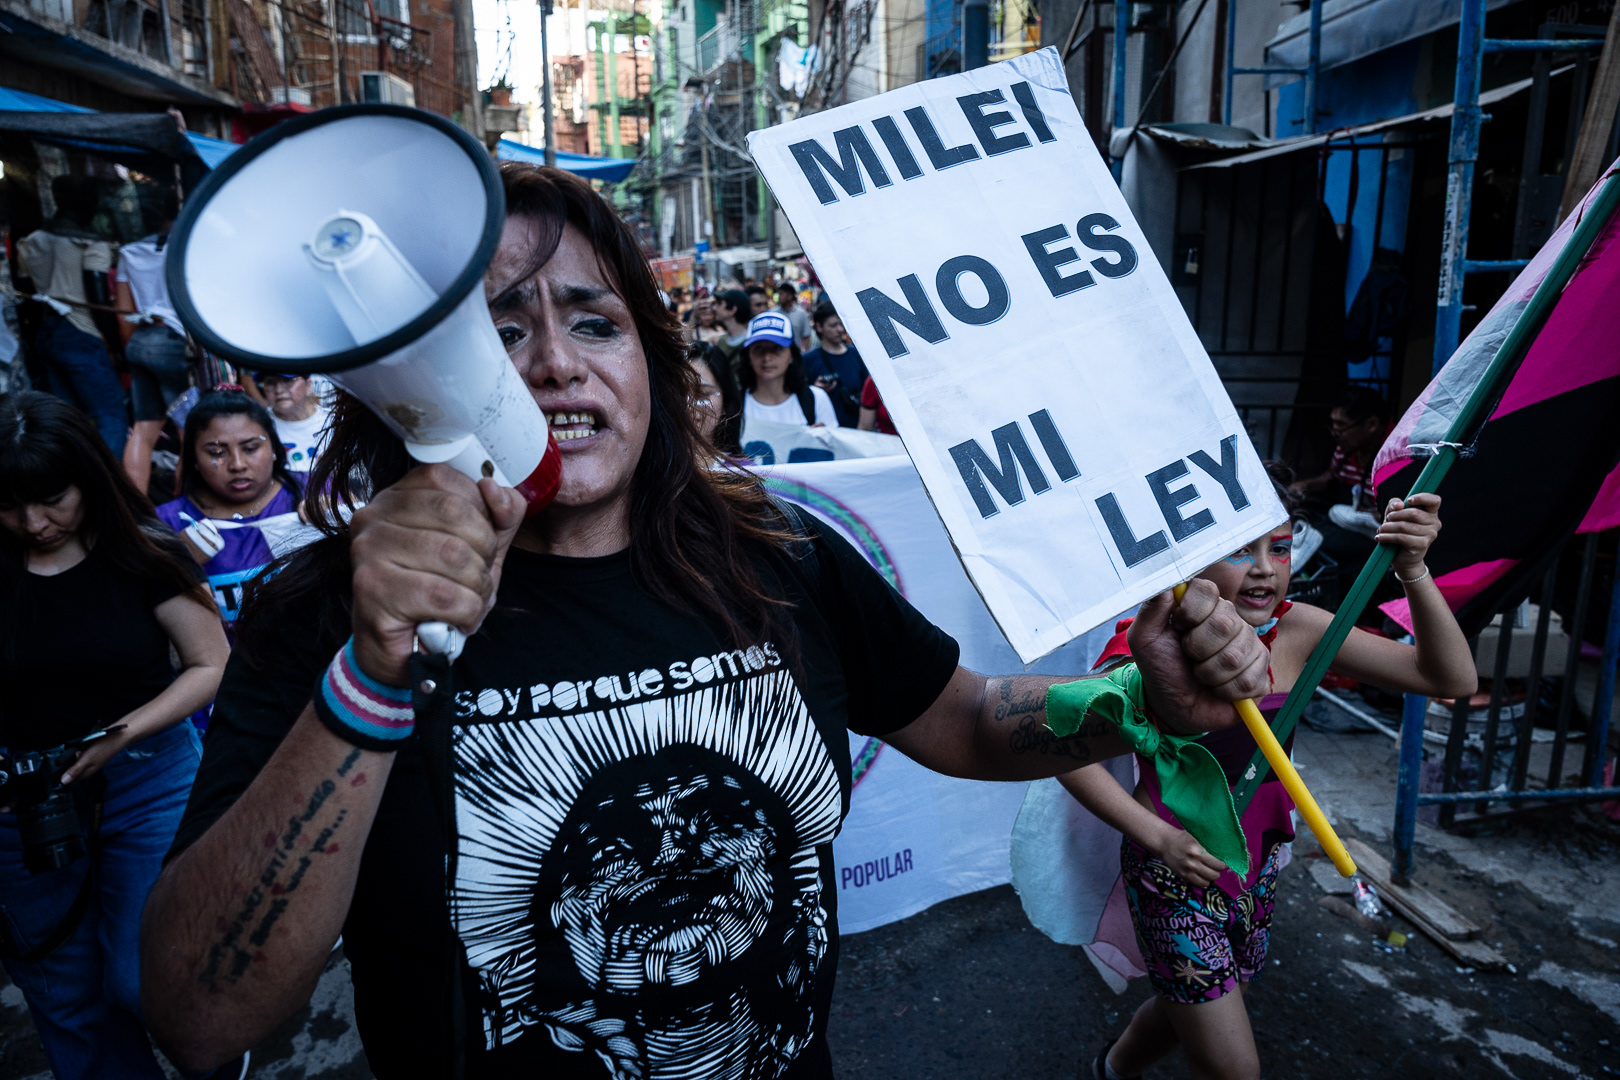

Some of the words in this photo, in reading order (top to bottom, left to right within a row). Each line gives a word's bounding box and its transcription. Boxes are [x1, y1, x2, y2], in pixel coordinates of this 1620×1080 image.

[788, 80, 1057, 206] MILEI
[855, 254, 1011, 360] NO
[1020, 212, 1139, 299] ES
[948, 407, 1082, 519] MI
[1094, 433, 1251, 569] LEY
[454, 687, 522, 717] soy
[529, 668, 665, 713] porque
[668, 641, 782, 690] somos
[841, 848, 913, 890] POPULAR
[1161, 915, 1195, 930] LOVE
